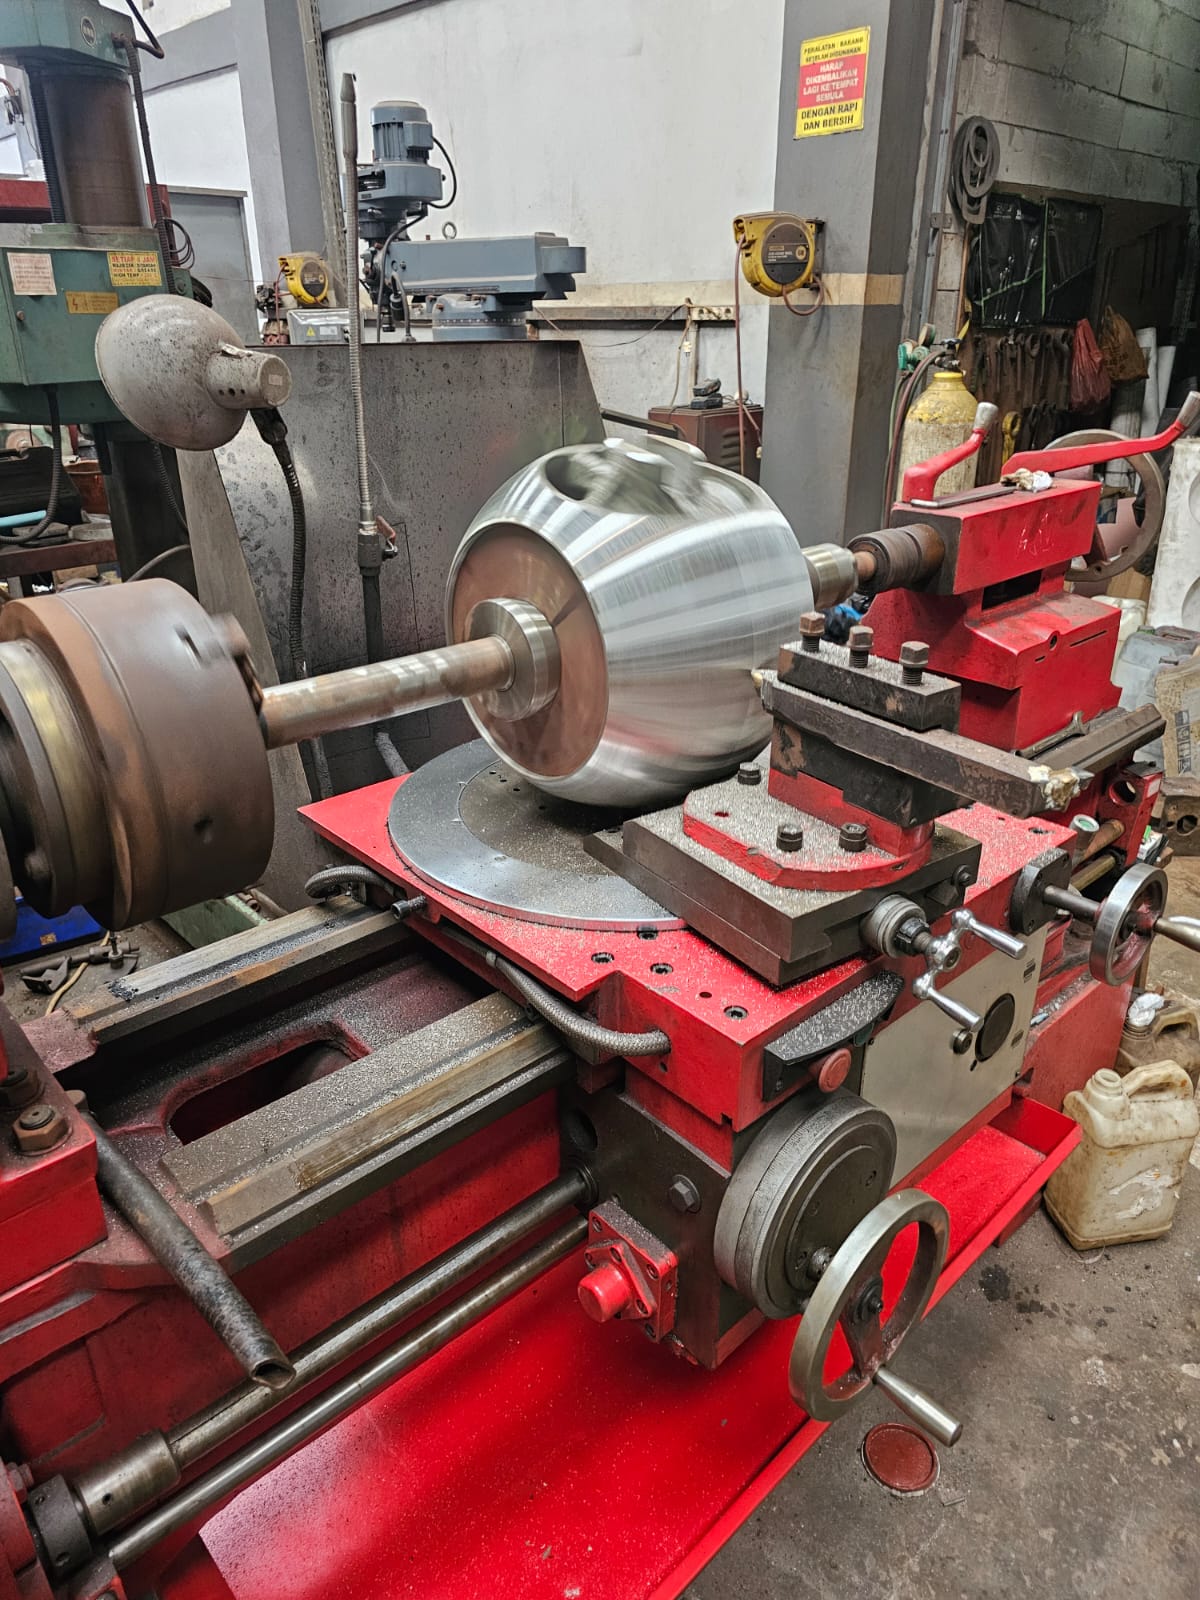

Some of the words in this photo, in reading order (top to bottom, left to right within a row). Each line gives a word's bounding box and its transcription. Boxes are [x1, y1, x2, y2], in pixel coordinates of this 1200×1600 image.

[804, 43, 835, 54] PERALATAN
[840, 37, 863, 47] BARANG
[820, 61, 844, 72] HARAP
[805, 68, 858, 85] DIKEMBALIKAN
[803, 85, 819, 95] LAGI
[820, 84, 830, 93] KE
[832, 78, 859, 90] TEMPAT
[816, 91, 844, 102] SEMULA
[801, 105, 835, 120] DENGAN
[838, 102, 858, 113] RAPI
[804, 120, 820, 131] DAN
[823, 115, 854, 128] BERSIH
